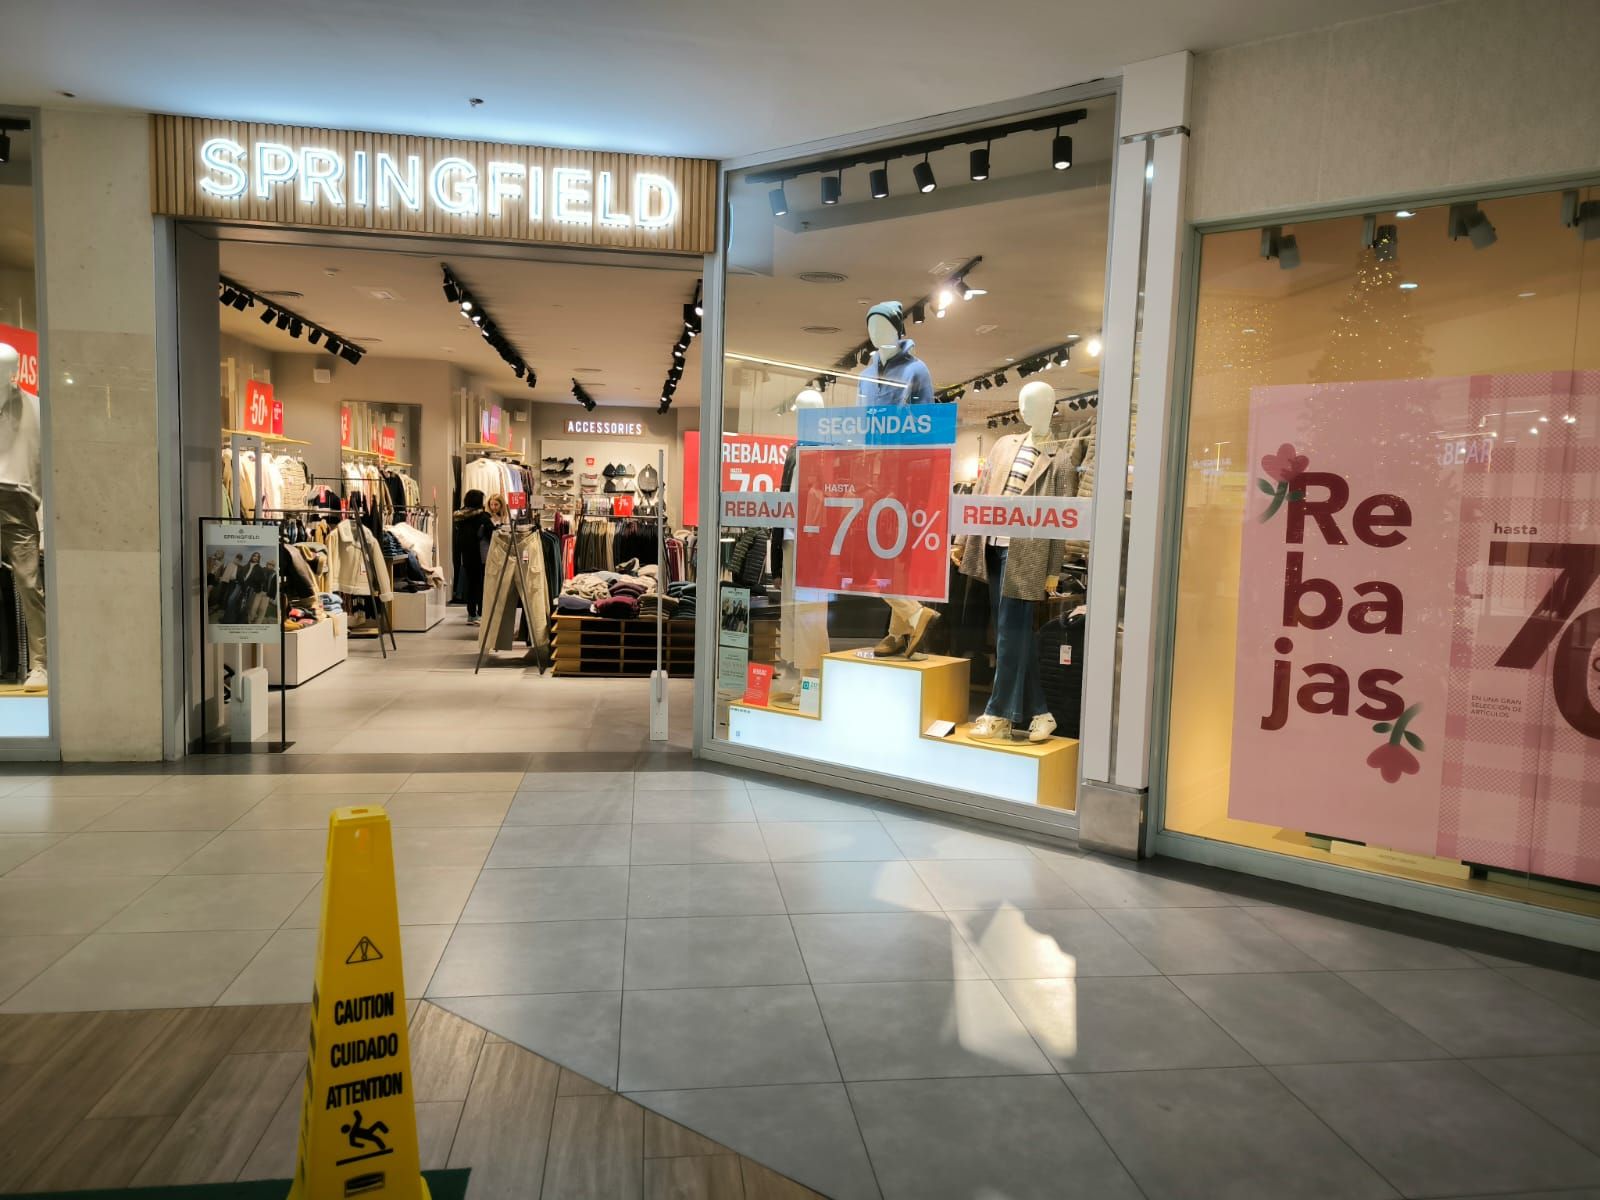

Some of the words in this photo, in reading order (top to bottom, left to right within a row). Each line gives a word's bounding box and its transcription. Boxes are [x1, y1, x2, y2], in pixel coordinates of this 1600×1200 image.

[199, 137, 681, 230] SPRINGFIELD
[567, 420, 642, 435] ACCESSORIES
[817, 414, 932, 435] SEGUNDAS
[824, 483, 855, 493] HASTA
[724, 500, 795, 519] REBAJA
[963, 505, 1079, 529] REBAJAS
[1285, 471, 1412, 548] Re
[803, 496, 941, 560] -70%
[1493, 522, 1538, 535] hasta
[1282, 551, 1404, 635] ba
[1260, 637, 1405, 731] jas
[334, 992, 394, 1026] CAUTION
[330, 1033, 398, 1068] CUIDADO
[325, 1072, 403, 1110] ATTENTION
